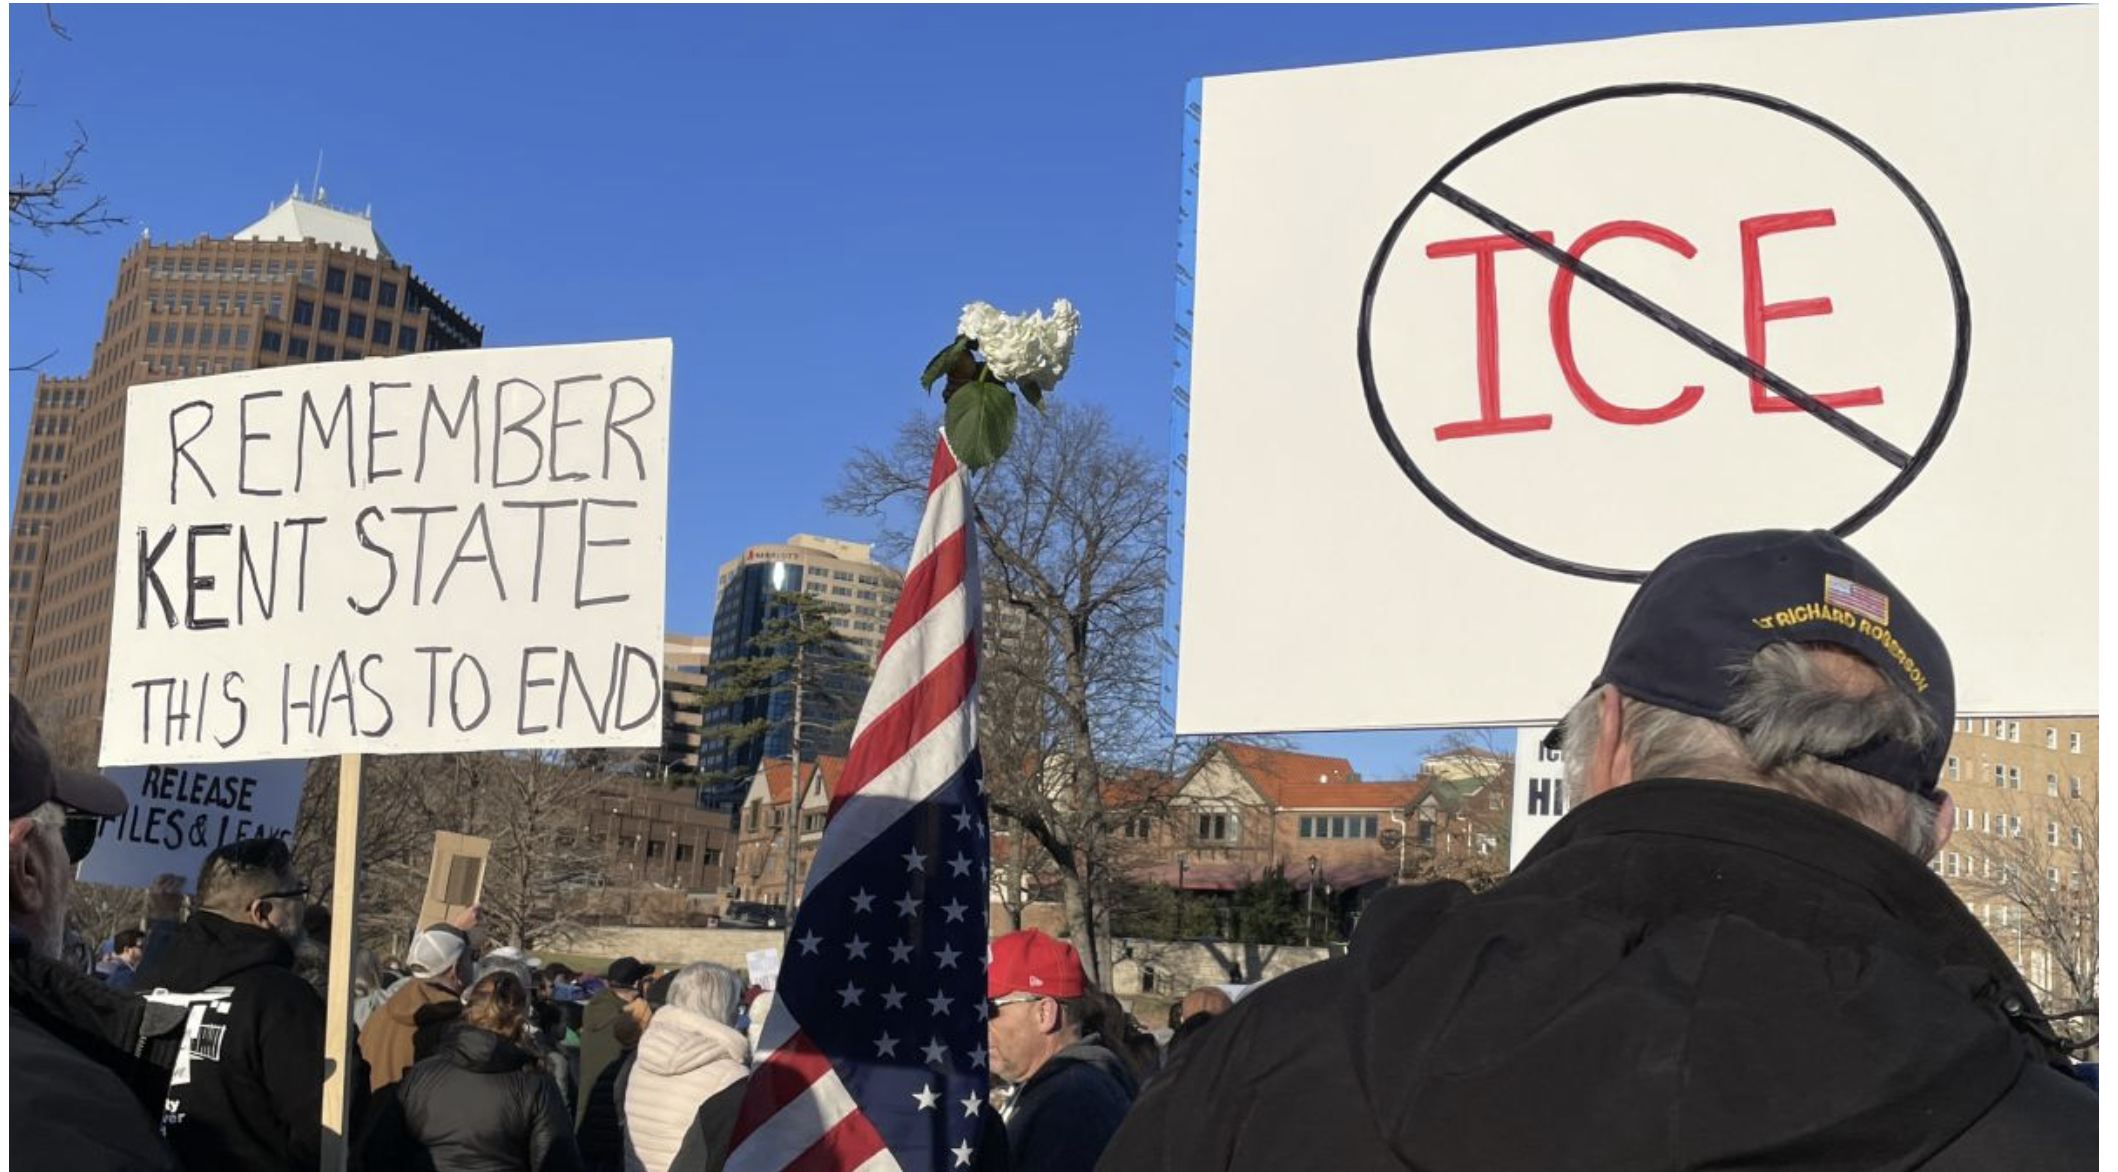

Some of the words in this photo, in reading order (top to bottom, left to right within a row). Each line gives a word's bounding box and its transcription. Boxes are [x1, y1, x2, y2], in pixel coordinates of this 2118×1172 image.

[1426, 207, 1885, 442] ICE
[169, 374, 656, 505] REMEMBER
[135, 516, 328, 630] KENT
[346, 498, 638, 616] STATE
[1776, 603, 1856, 628] RICHARD
[131, 669, 248, 749] THIS
[281, 650, 394, 745] HAS
[414, 645, 491, 732] TO
[516, 642, 662, 736] END
[142, 766, 257, 812] RELEASE
[188, 813, 208, 848] &
